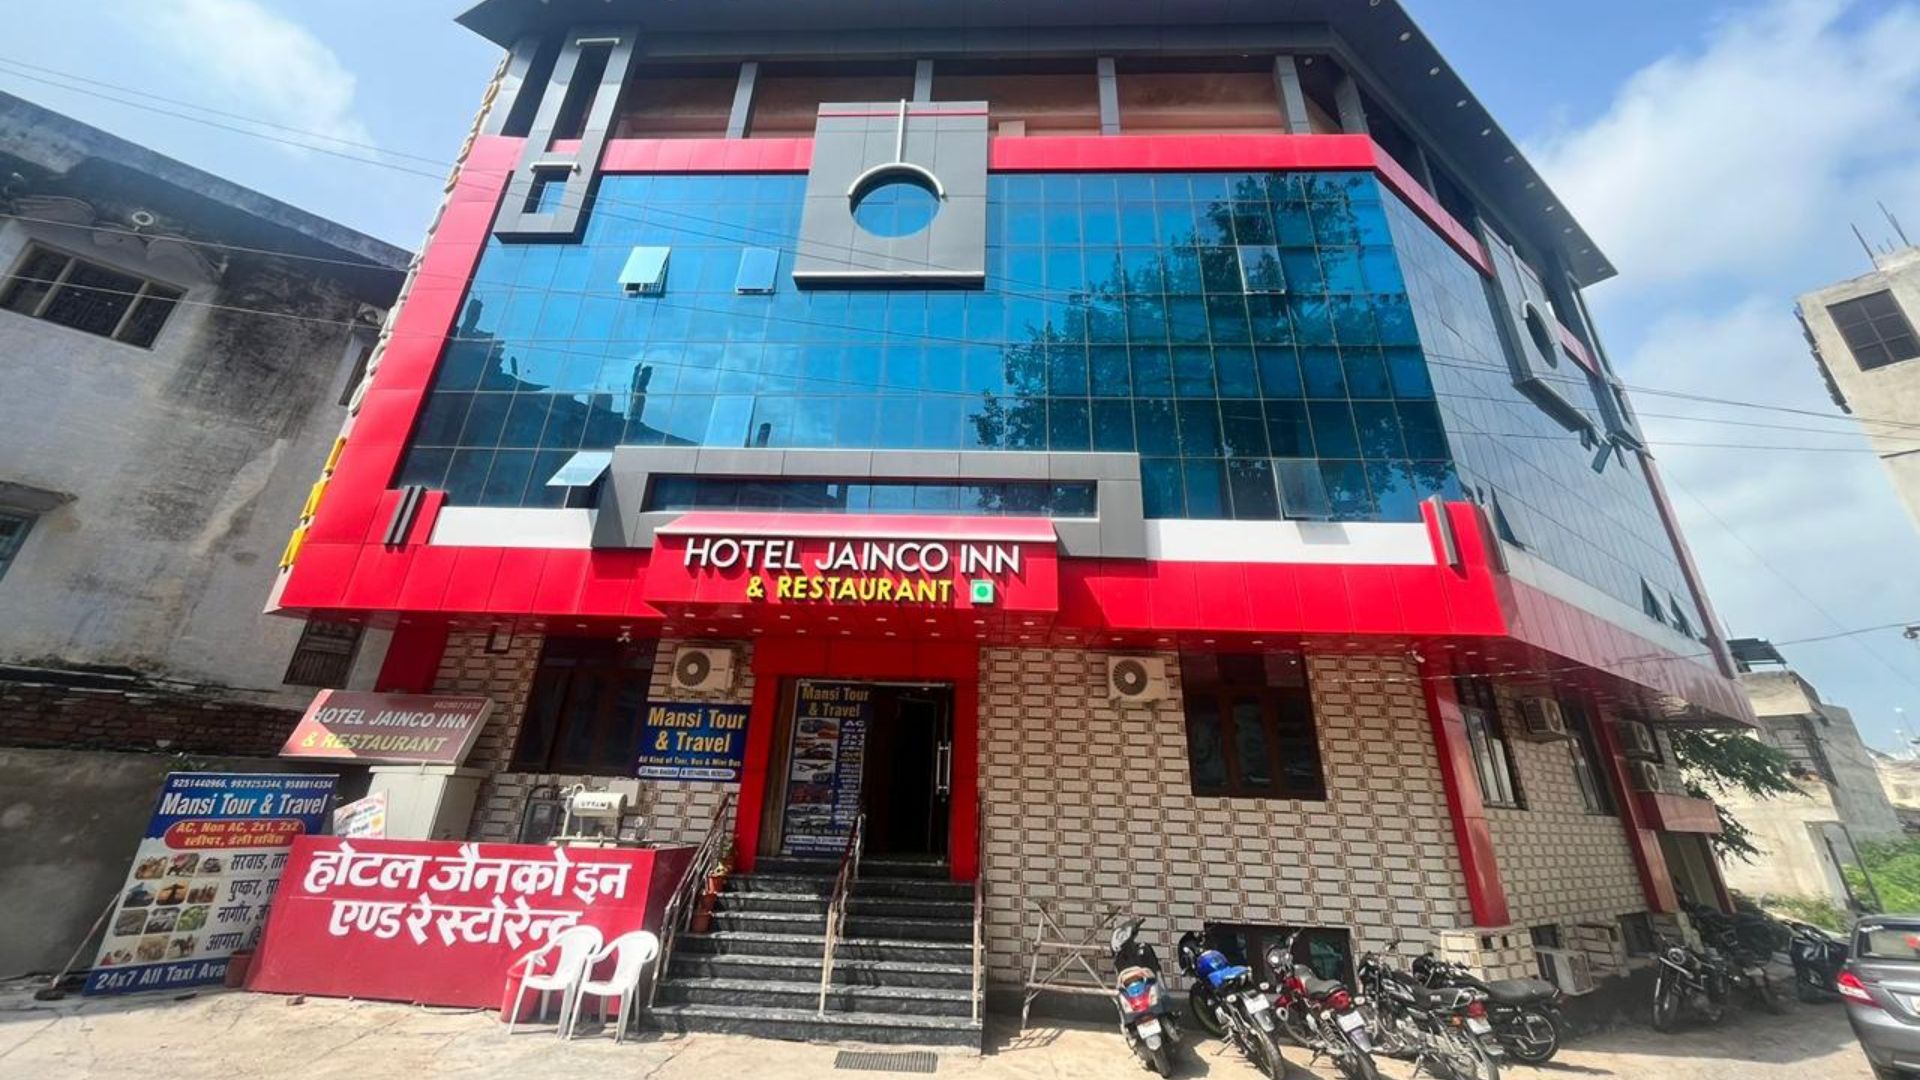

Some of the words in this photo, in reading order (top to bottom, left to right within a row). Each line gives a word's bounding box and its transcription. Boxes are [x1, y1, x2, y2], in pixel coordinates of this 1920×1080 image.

[684, 538, 800, 569] HOTEL
[815, 541, 949, 573] JAINCO
[960, 544, 1020, 574] INN
[745, 575, 764, 599] &
[776, 576, 952, 603] RESTAURANT
[802, 686, 840, 701] Mansi
[843, 687, 869, 702] Tour
[312, 707, 366, 725] HOTEL
[369, 710, 433, 729] JAINCO
[436, 713, 472, 729] INN
[647, 707, 702, 728] Mansi
[709, 709, 746, 729] Tour
[808, 702, 818, 716] &
[822, 702, 861, 717] Travel
[302, 732, 319, 748] &
[321, 734, 448, 752] RESTAURANT
[655, 730, 669, 751] &
[676, 731, 731, 753] Travel
[159, 793, 218, 815] Mansi
[220, 793, 257, 815] Tour
[259, 793, 274, 815] &
[278, 794, 328, 815] Travel
[175, 822, 197, 834] AC,
[201, 822, 227, 833] Non
[278, 822, 299, 832] 2x2
[303, 842, 432, 893] होटल
[428, 842, 574, 897] जैनको
[572, 861, 632, 904] इन
[228, 880, 262, 902] पुष्कर,
[329, 900, 406, 938] एण्ड
[95, 970, 138, 990] 24x7
[138, 968, 162, 985] All
[166, 964, 198, 982] Taxi
